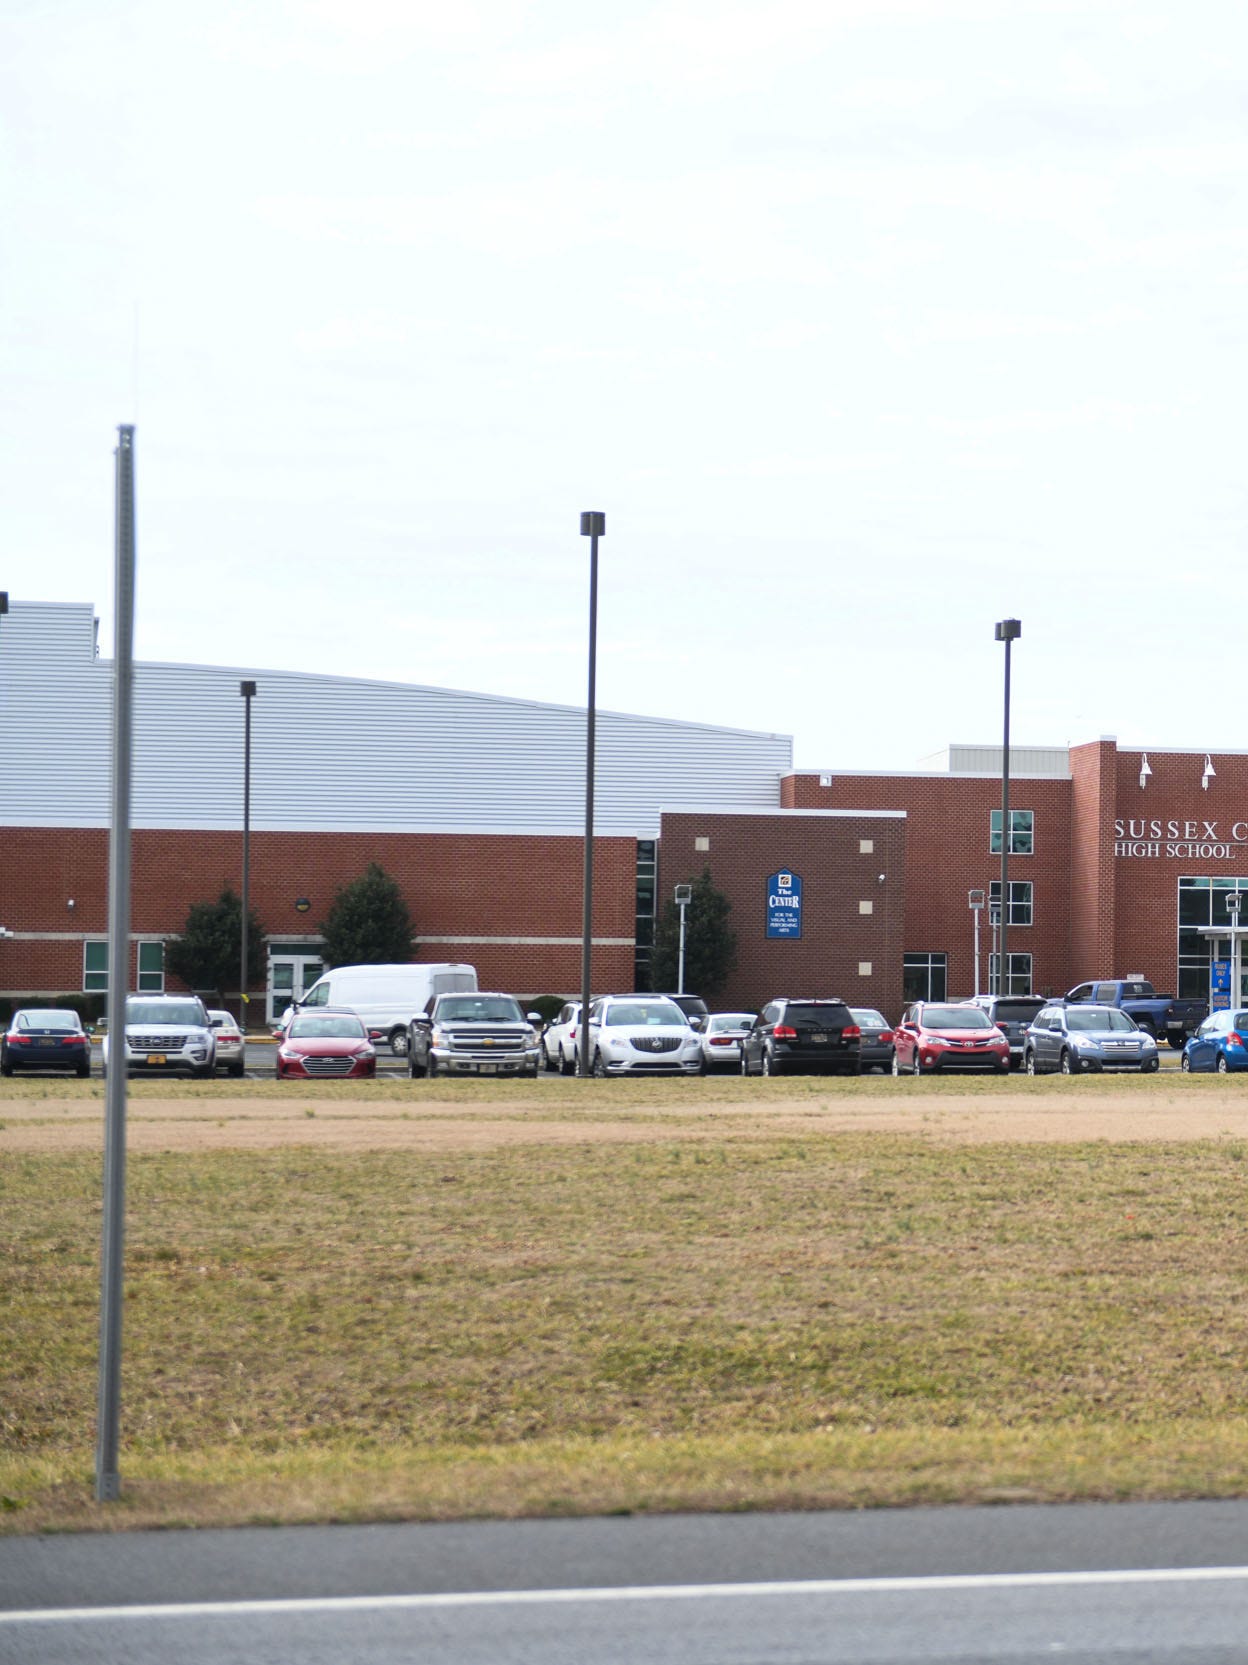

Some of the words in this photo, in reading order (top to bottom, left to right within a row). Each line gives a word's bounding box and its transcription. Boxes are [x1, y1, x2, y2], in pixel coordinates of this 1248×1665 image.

[1115, 819, 1218, 840] SUSSEX
[1114, 842, 1160, 857] HIGH
[1166, 843, 1235, 859] SCHOOL
[769, 895, 799, 908] CENTER
